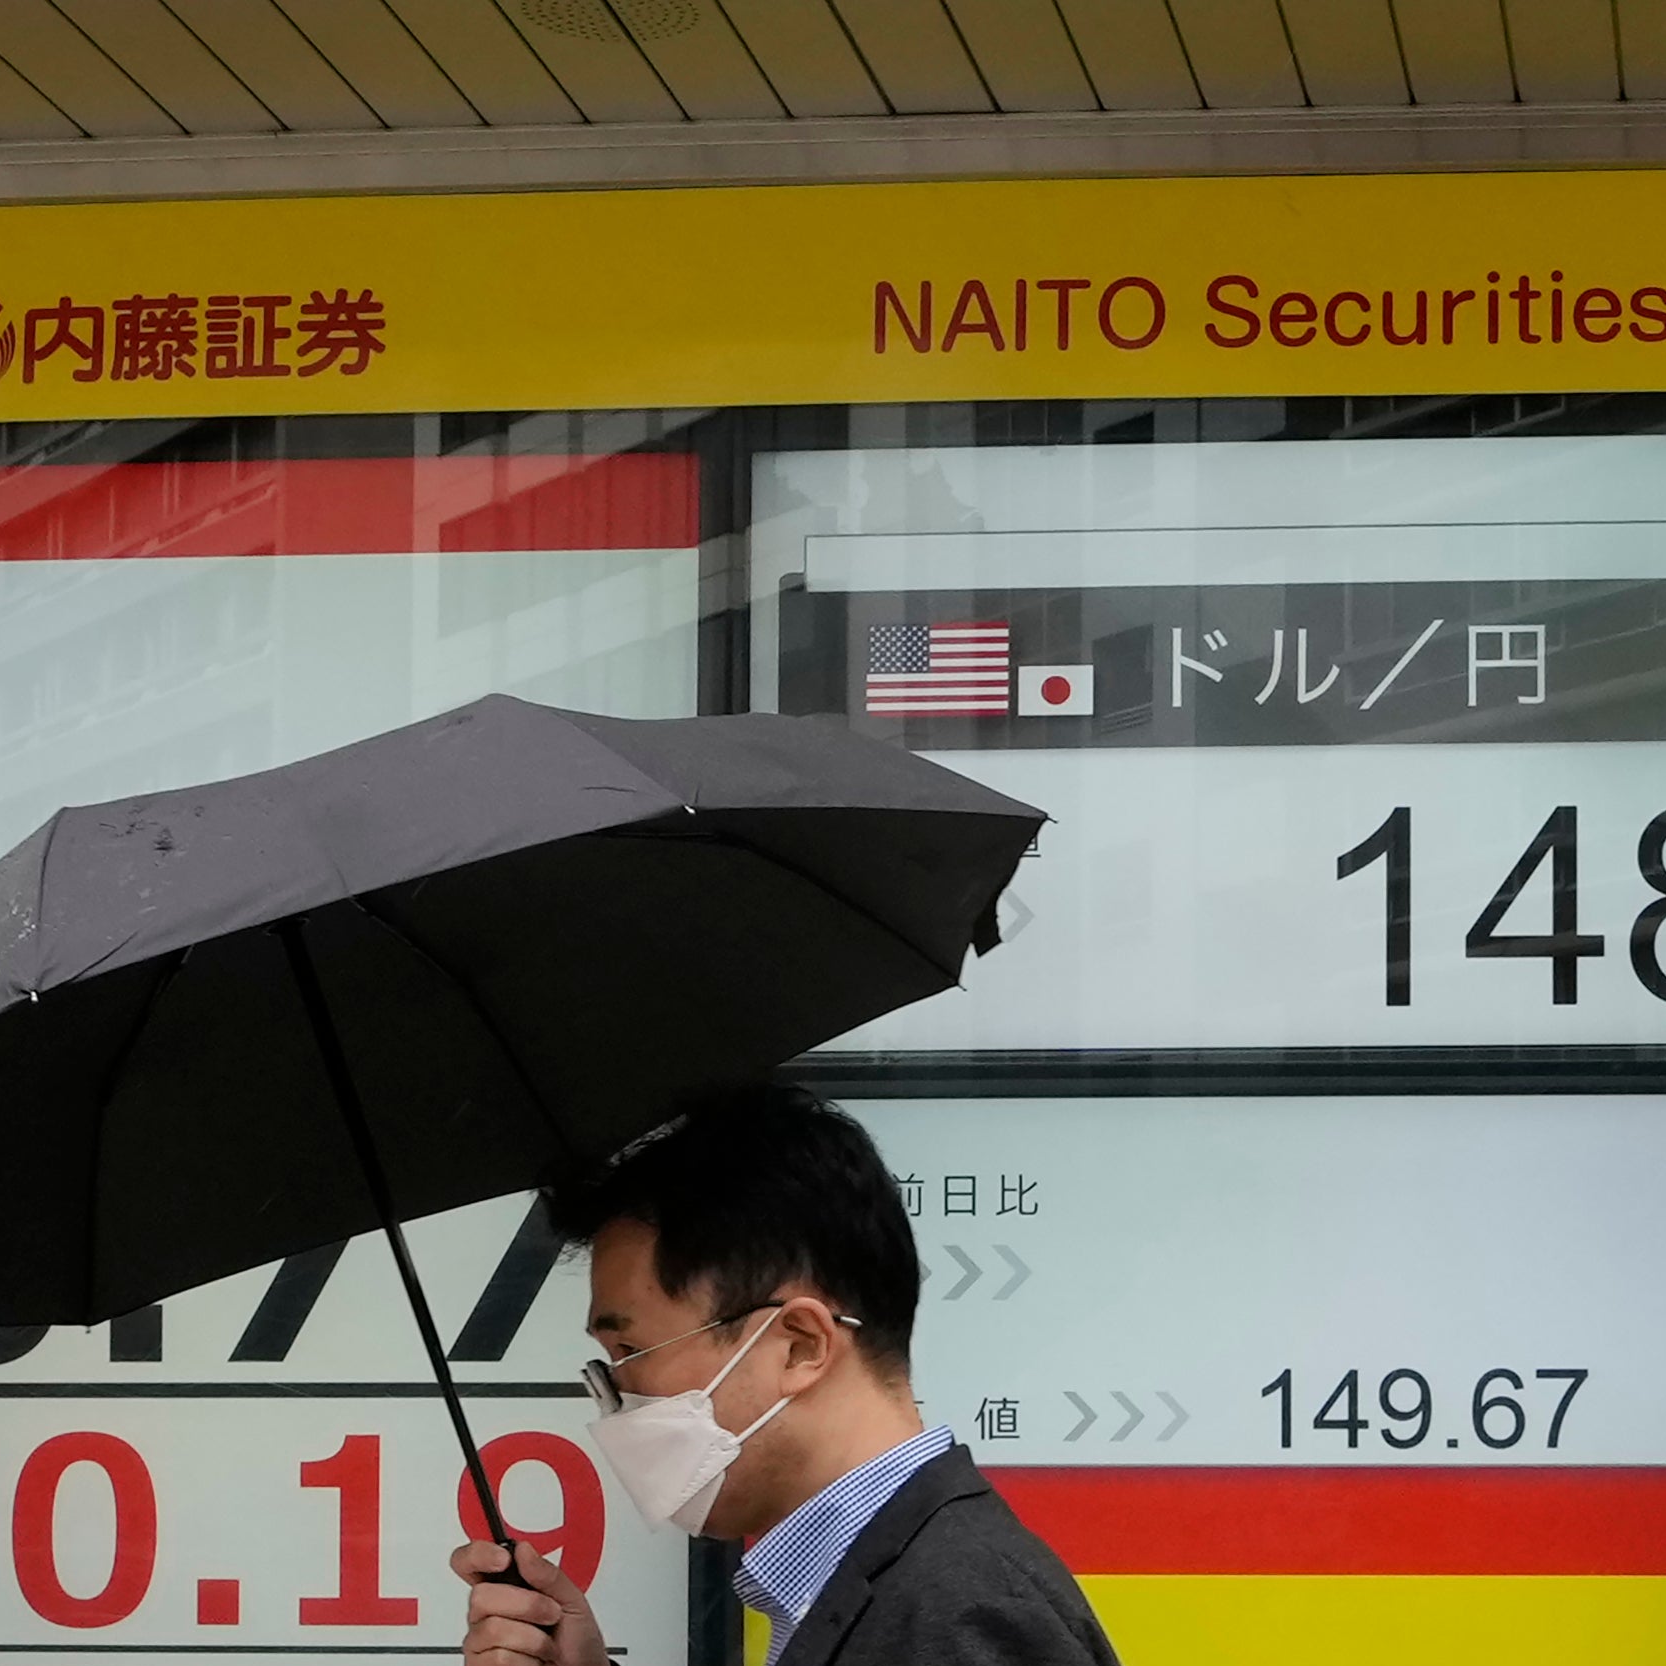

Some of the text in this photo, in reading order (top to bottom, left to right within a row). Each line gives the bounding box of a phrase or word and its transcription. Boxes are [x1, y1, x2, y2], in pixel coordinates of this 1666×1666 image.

[22, 288, 386, 384] 内藤証券
[874, 276, 1167, 354] NAITO
[892, 1173, 1039, 1217] 前日比
[1260, 1368, 1589, 1450] 149.67
